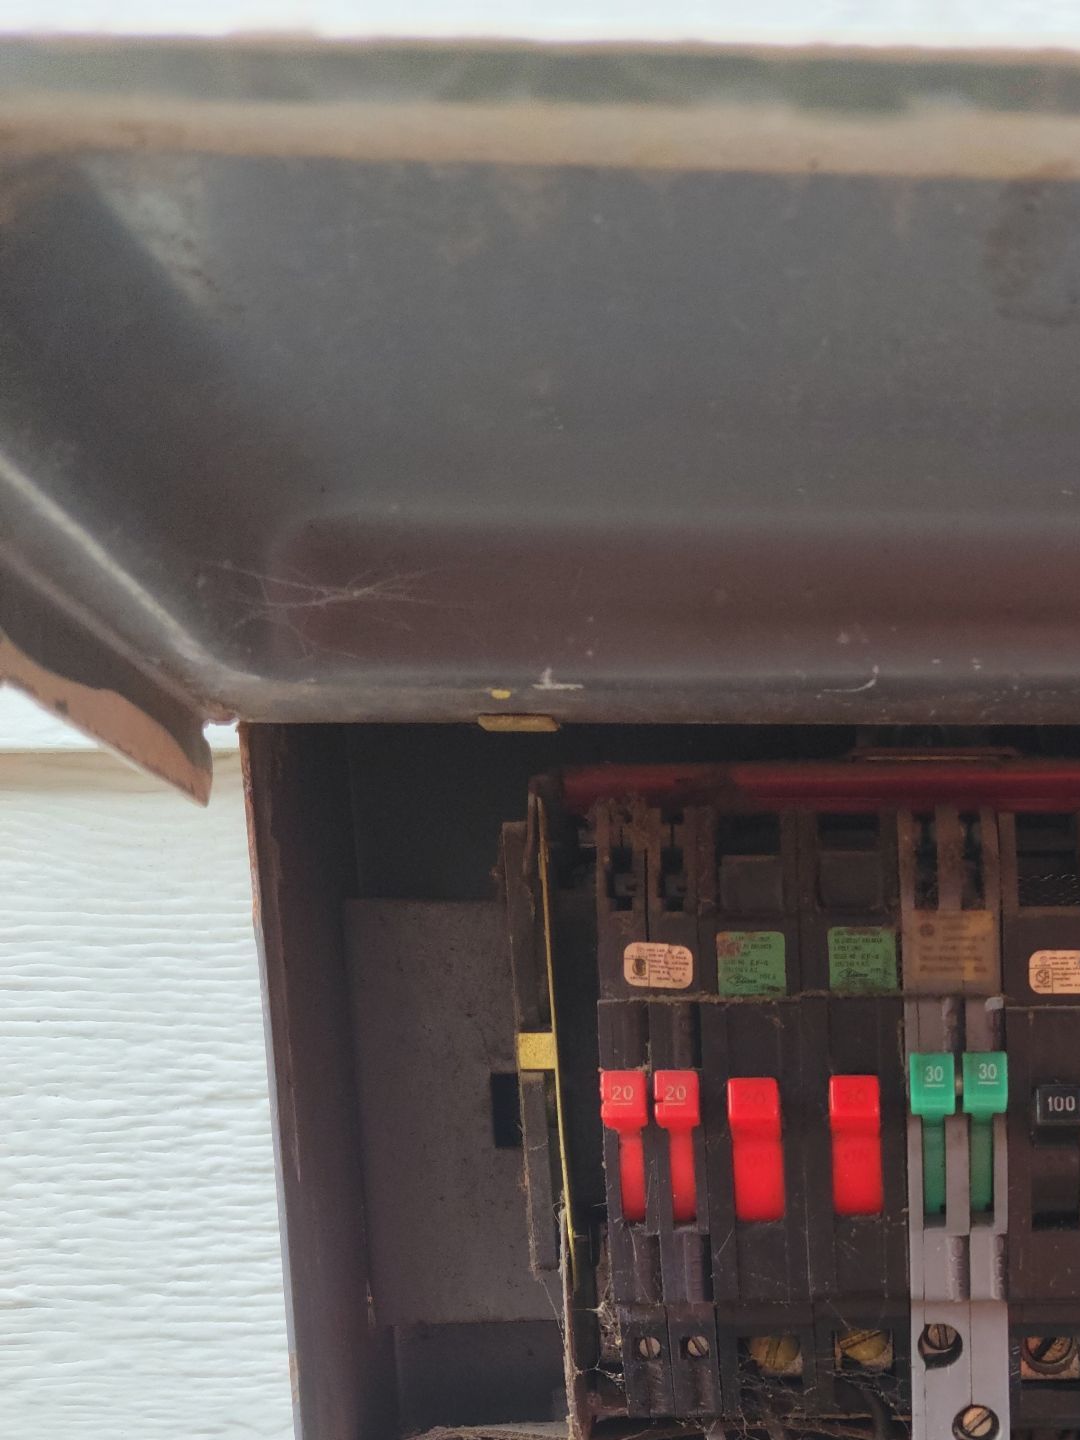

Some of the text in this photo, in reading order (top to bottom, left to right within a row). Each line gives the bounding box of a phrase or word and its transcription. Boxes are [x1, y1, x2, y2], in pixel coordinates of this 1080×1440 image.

[925, 1065, 944, 1082] 30
[978, 1063, 997, 1080] 30
[611, 1086, 634, 1100] 20
[664, 1086, 687, 1100] 20
[1047, 1095, 1076, 1112] 100
